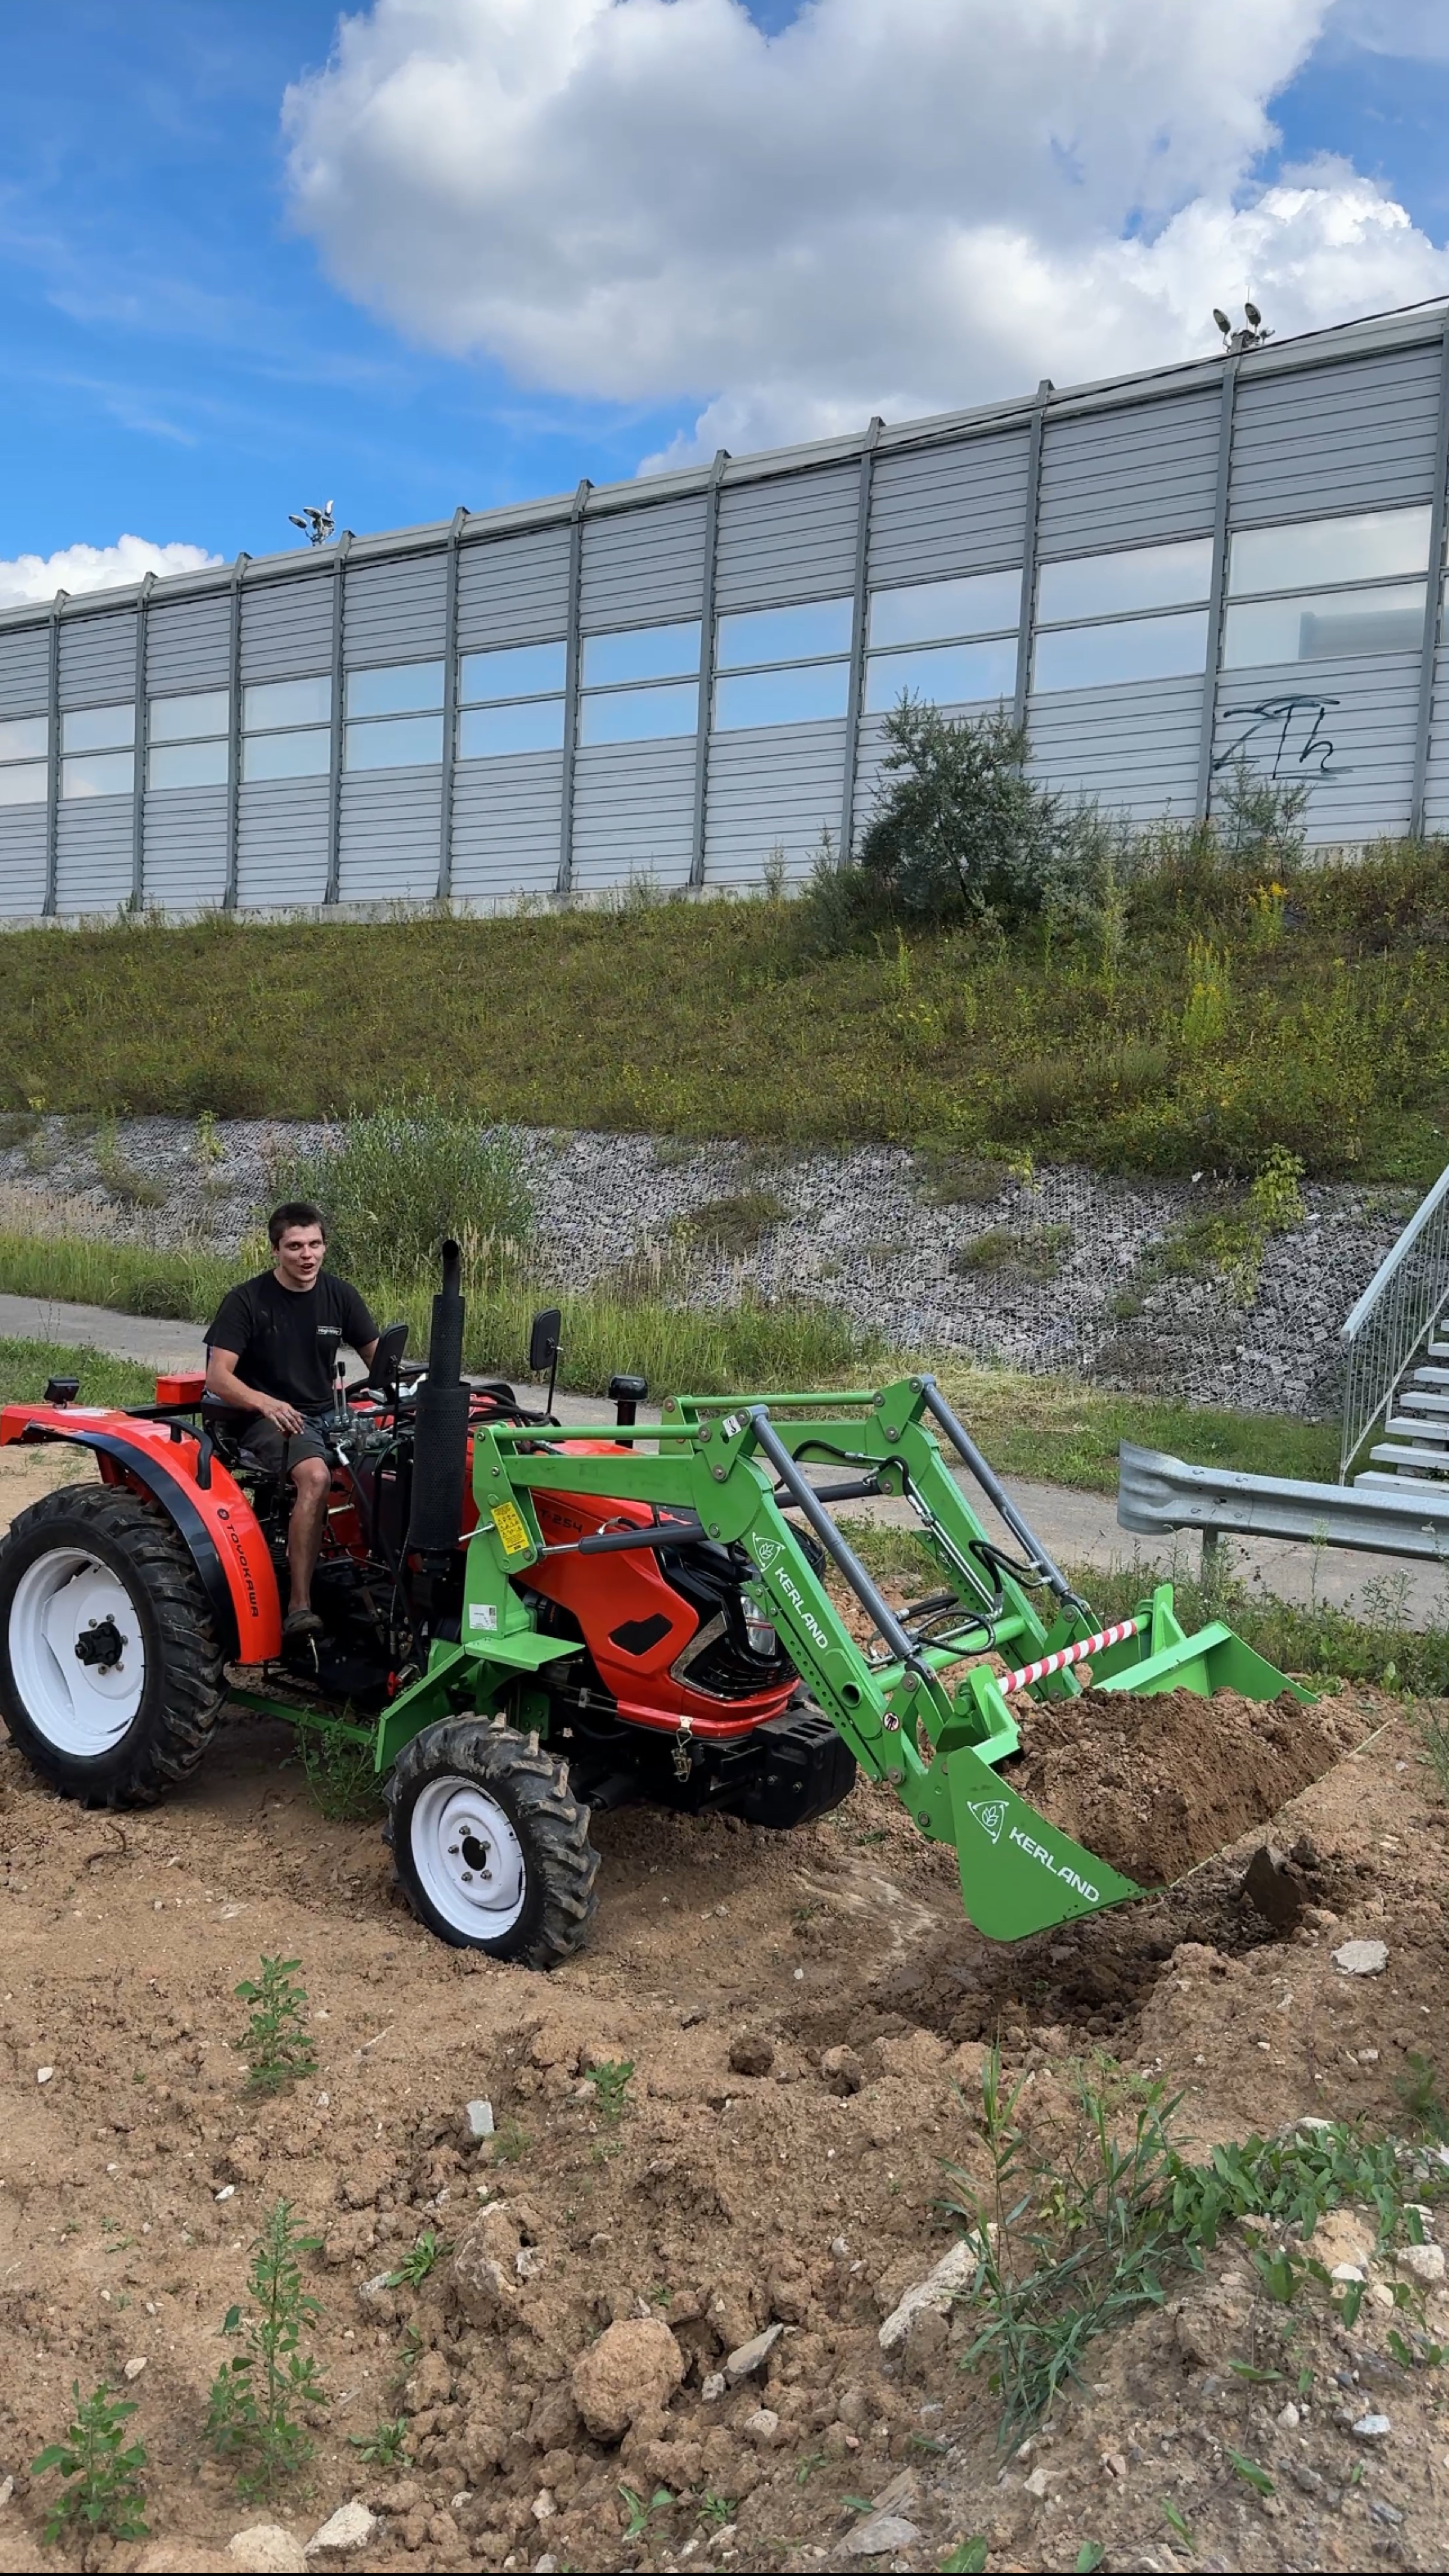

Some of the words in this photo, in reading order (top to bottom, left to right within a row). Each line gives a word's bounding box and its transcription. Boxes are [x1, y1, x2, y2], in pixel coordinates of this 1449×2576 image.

[540, 1508, 583, 1533] T-254
[226, 1524, 259, 1617] TOYOKAWA
[775, 1567, 828, 1649] KERLAND
[1009, 1827, 1100, 1902] KERLAND
